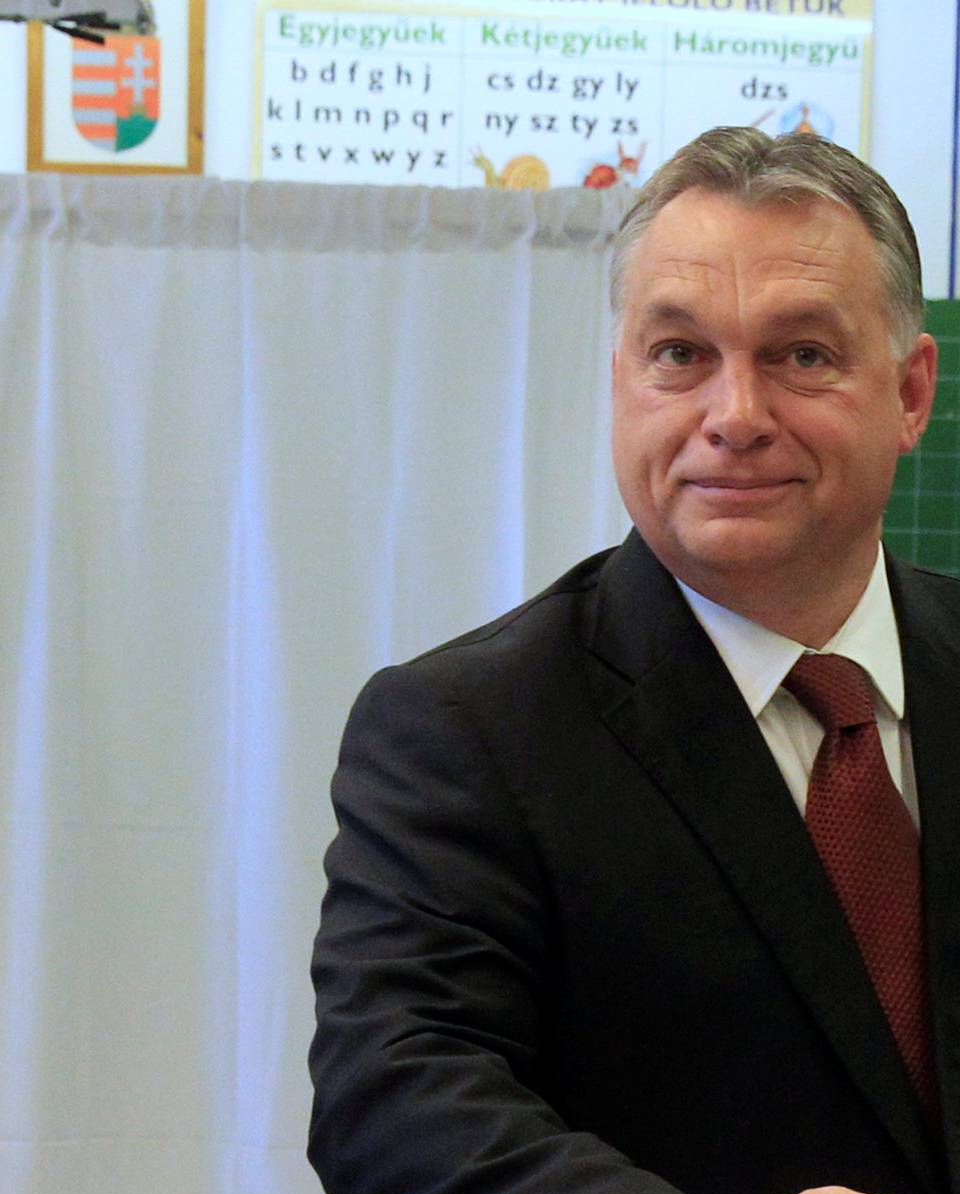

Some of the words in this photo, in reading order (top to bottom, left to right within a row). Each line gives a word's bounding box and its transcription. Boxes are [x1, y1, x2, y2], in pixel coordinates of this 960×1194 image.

[290, 60, 308, 83] b
[319, 61, 337, 84] d
[348, 61, 359, 84] f
[367, 69, 386, 93] g
[395, 63, 413, 86] h
[421, 64, 432, 94] j
[486, 73, 515, 90] cs
[526, 68, 559, 92] dz
[572, 76, 606, 101] gy
[616, 71, 641, 102] ly
[740, 76, 789, 101] dzs
[266, 97, 283, 121] k
[295, 98, 302, 122] l
[313, 106, 343, 123] m
[354, 108, 371, 125] n
[382, 109, 401, 133] p
[411, 110, 429, 134] q
[441, 111, 454, 128] r
[485, 112, 519, 138] ny
[530, 114, 558, 133] sz
[570, 113, 600, 140] ty
[611, 117, 640, 136] zs
[271, 144, 283, 161] s
[294, 142, 304, 162] t
[317, 146, 332, 162] v
[344, 147, 359, 164] x
[371, 149, 395, 166] w
[406, 150, 422, 173] y
[434, 151, 447, 168] z
